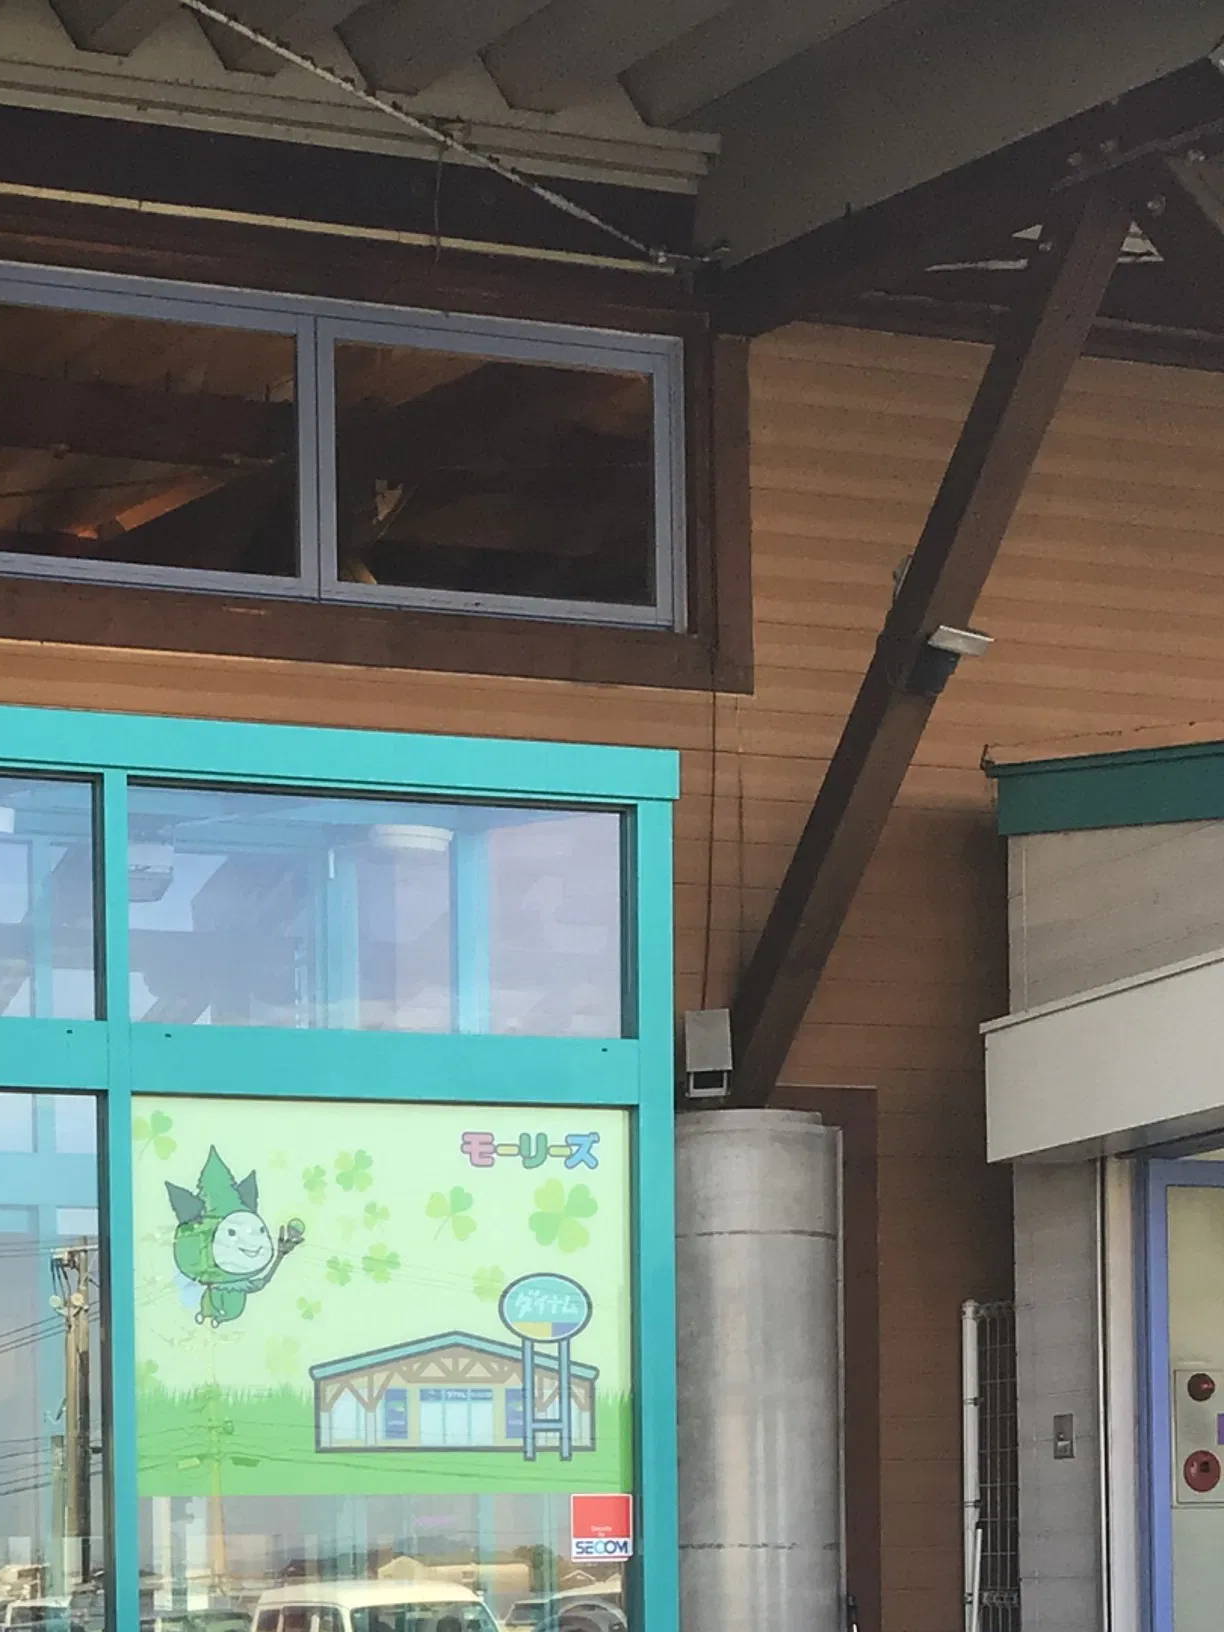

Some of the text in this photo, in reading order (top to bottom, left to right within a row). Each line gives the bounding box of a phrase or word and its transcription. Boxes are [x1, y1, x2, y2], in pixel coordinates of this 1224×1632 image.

[461, 1131, 600, 1170] モーリーズ
[515, 1289, 579, 1320] ダイナム
[575, 1540, 628, 1554] SECOM
